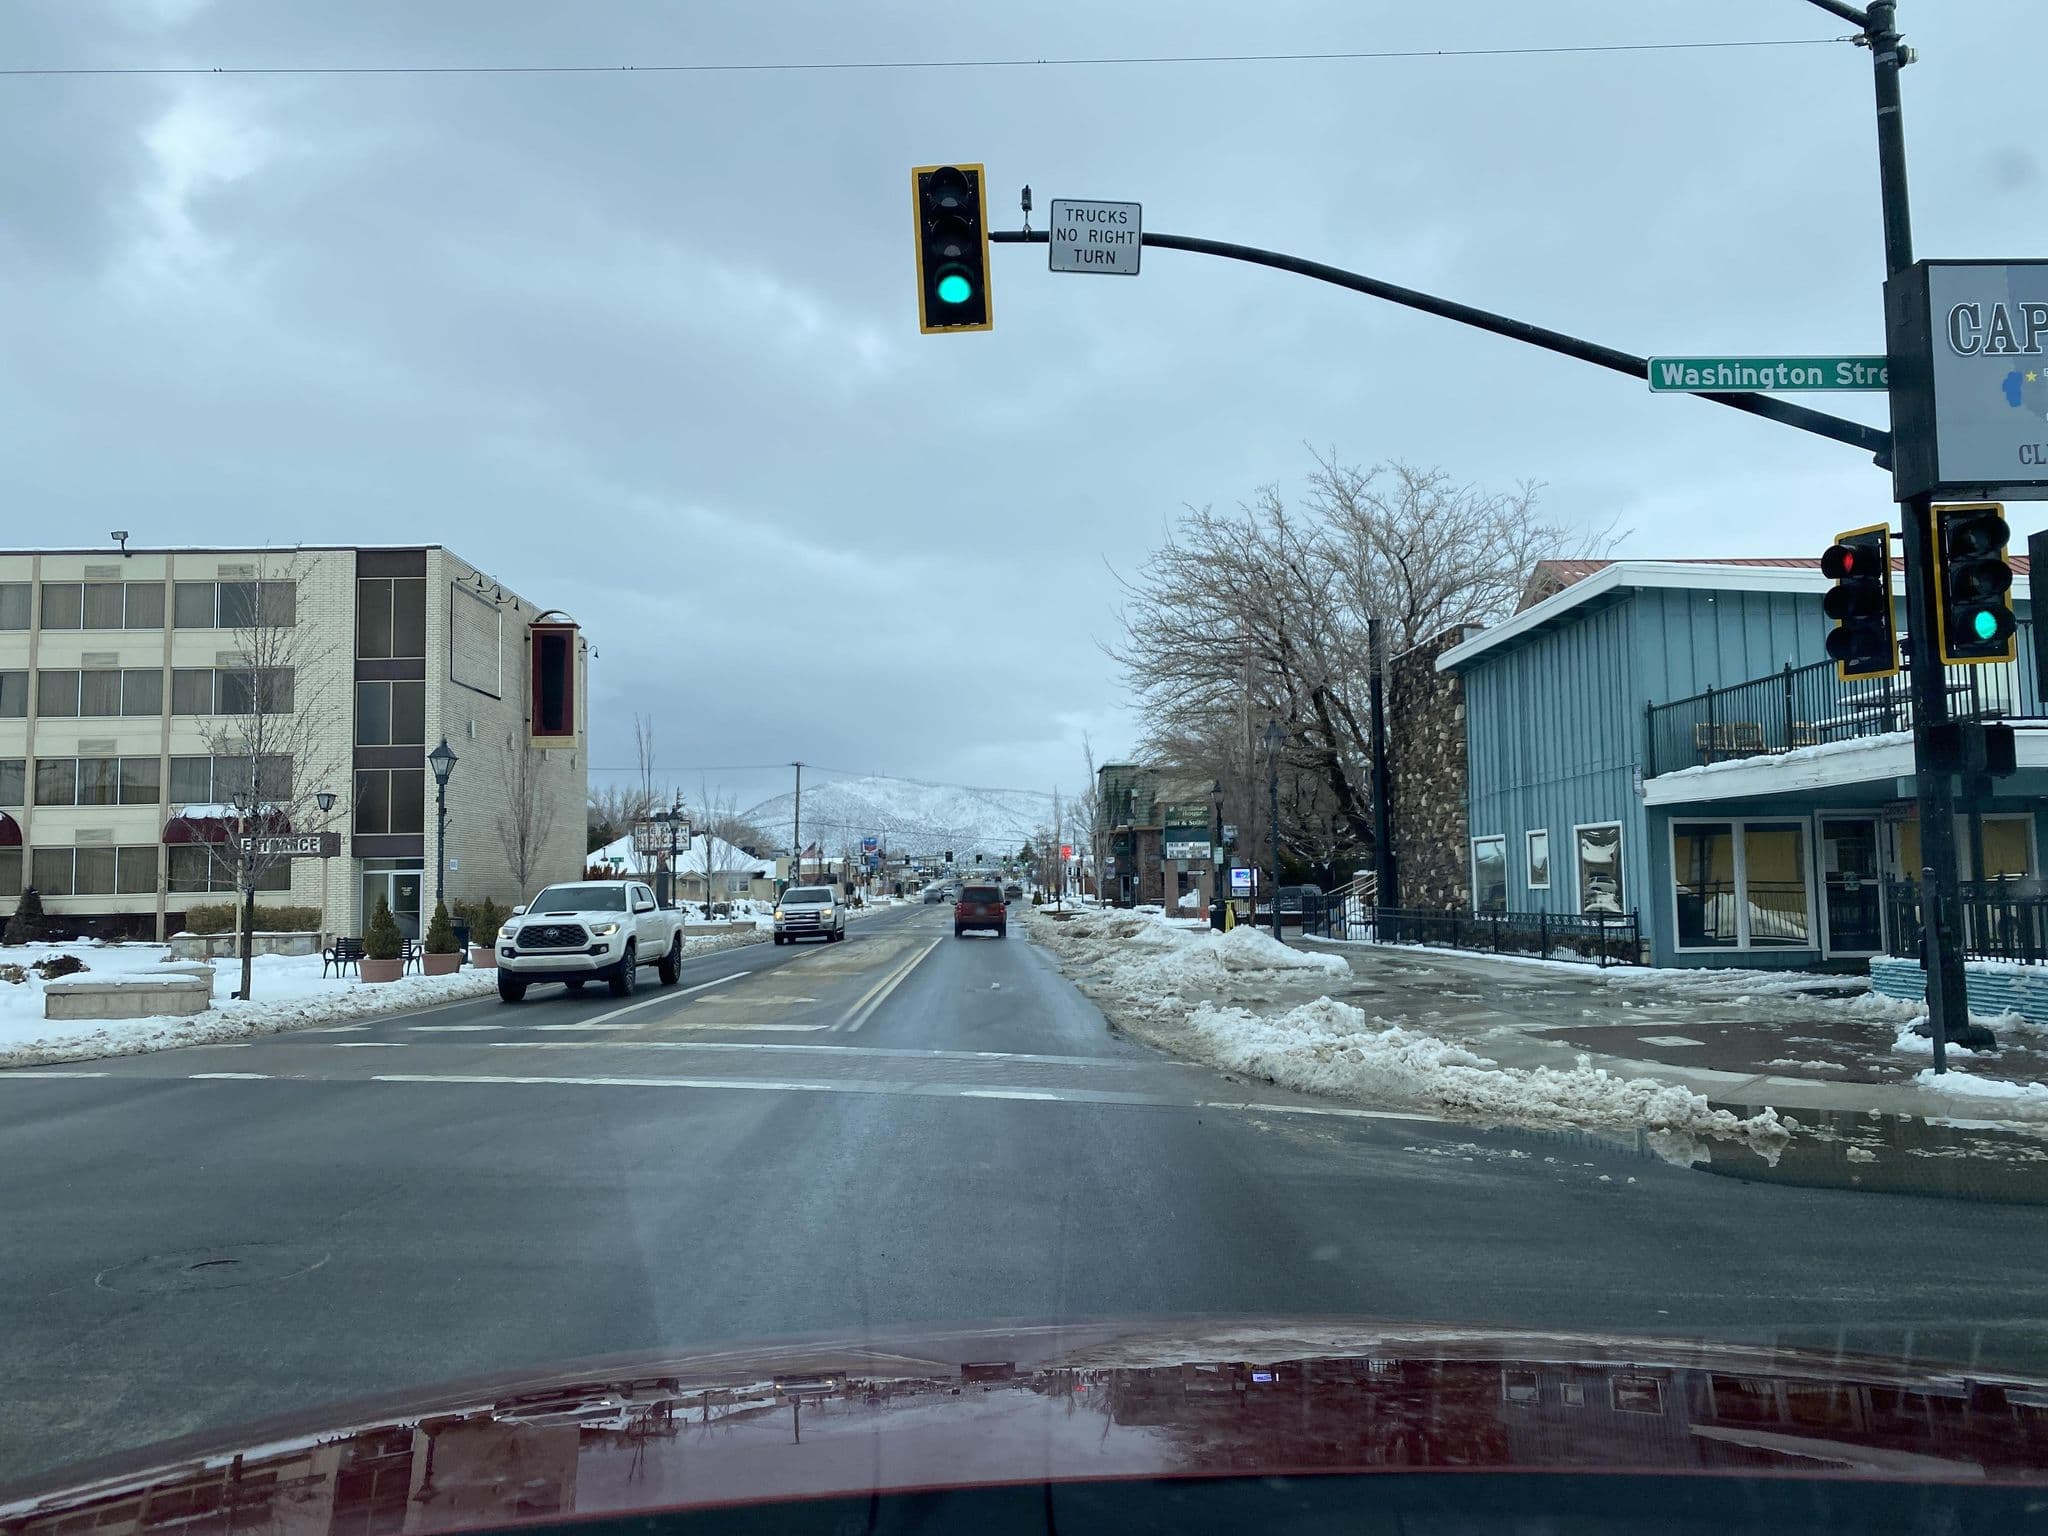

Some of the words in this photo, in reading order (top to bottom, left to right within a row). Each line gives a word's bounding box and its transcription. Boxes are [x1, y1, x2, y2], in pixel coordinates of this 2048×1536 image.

[1065, 208, 1128, 224] TRUCKS
[1056, 228, 1078, 242] NO
[1088, 229, 1135, 244] RIGHT
[1074, 249, 1116, 264] TURN
[1948, 302, 2048, 356] CAP
[1661, 362, 1823, 390] Washington
[2018, 443, 2048, 465] CL
[660, 827, 687, 835] SMTH
[243, 838, 318, 852] ETRANCE
